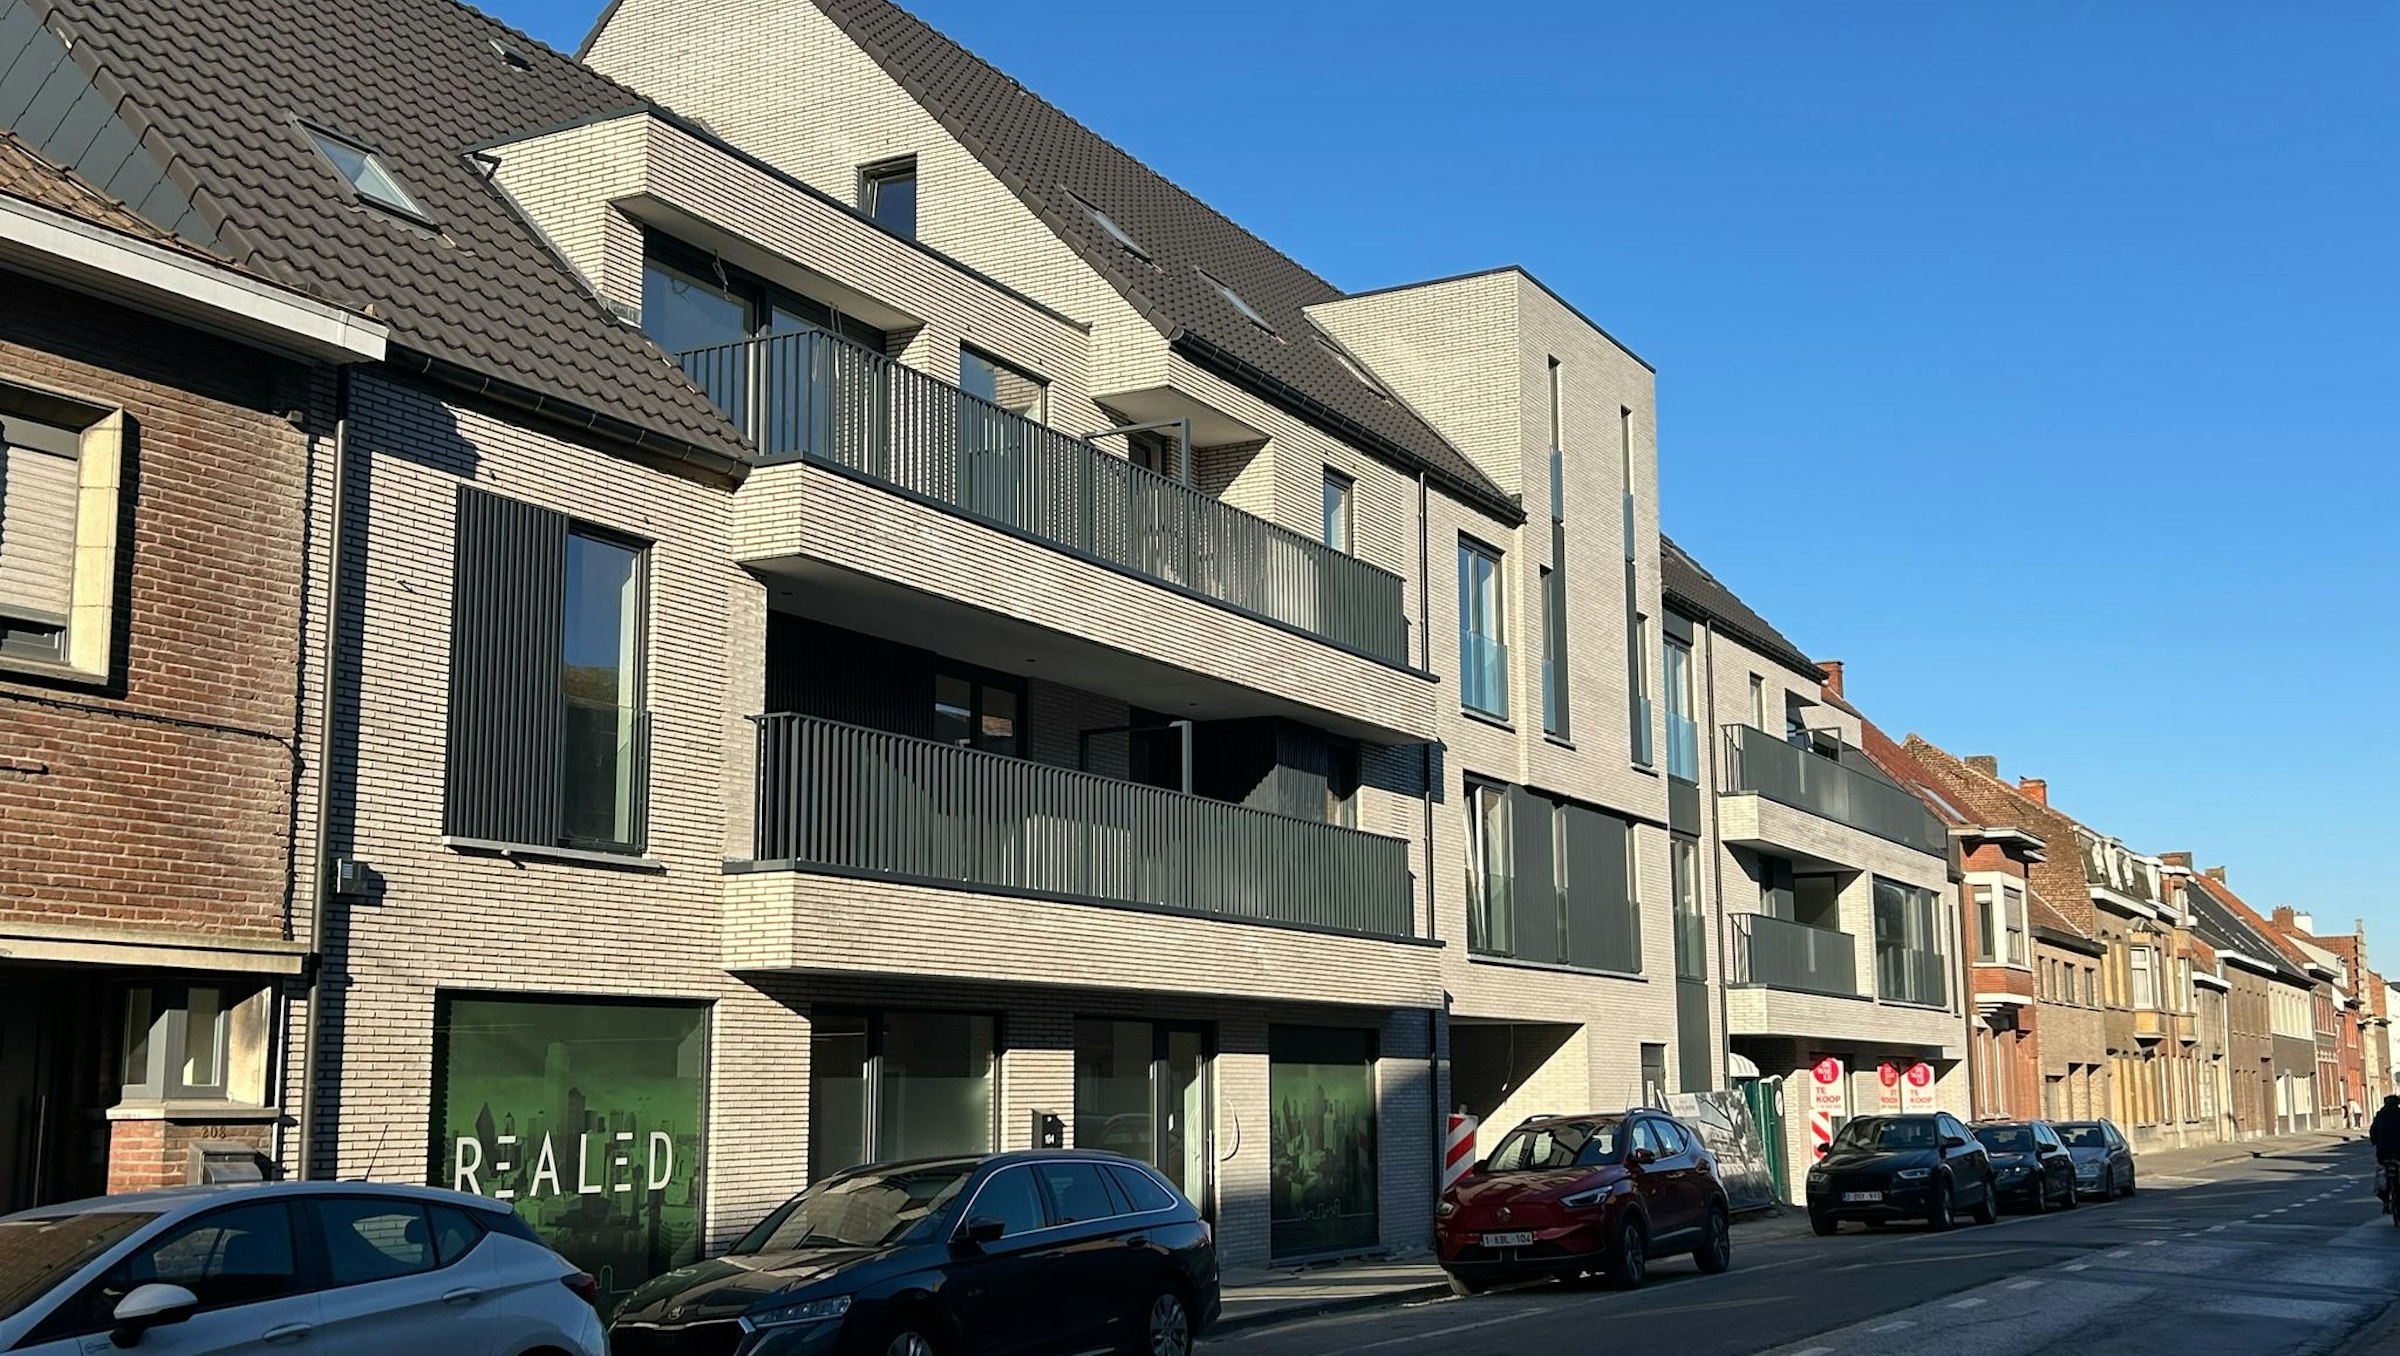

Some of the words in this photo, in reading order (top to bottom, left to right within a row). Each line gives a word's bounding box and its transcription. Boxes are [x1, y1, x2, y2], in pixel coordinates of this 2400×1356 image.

[1815, 1086, 1827, 1095] TE
[1816, 1095, 1841, 1104] KOOP
[1910, 1096, 1933, 1104] KOOP
[202, 1125, 226, 1139] 208
[455, 1130, 673, 1198] REALED
